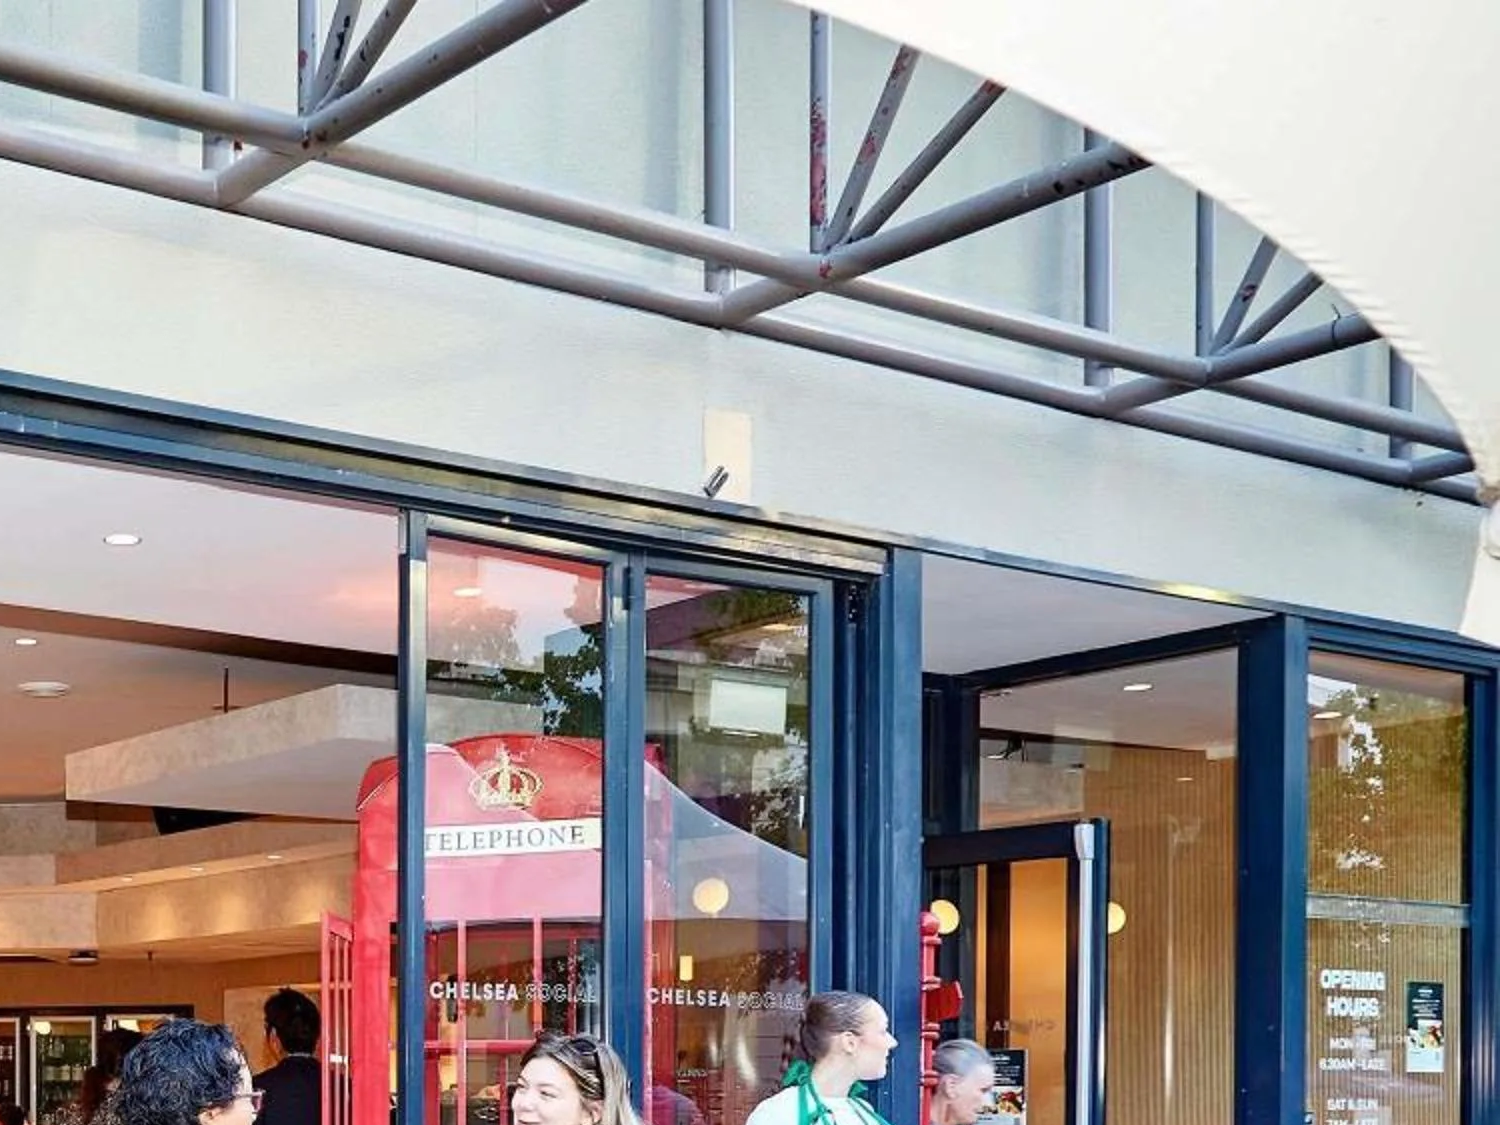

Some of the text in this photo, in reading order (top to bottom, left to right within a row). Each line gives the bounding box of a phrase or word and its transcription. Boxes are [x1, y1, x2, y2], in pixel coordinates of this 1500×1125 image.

[425, 825, 585, 851] TELEPHONE
[1320, 968, 1386, 991] OPENING
[429, 981, 519, 1000] CHELSEA
[646, 987, 731, 1007] CHELSEA
[1327, 997, 1380, 1017] HOURS
